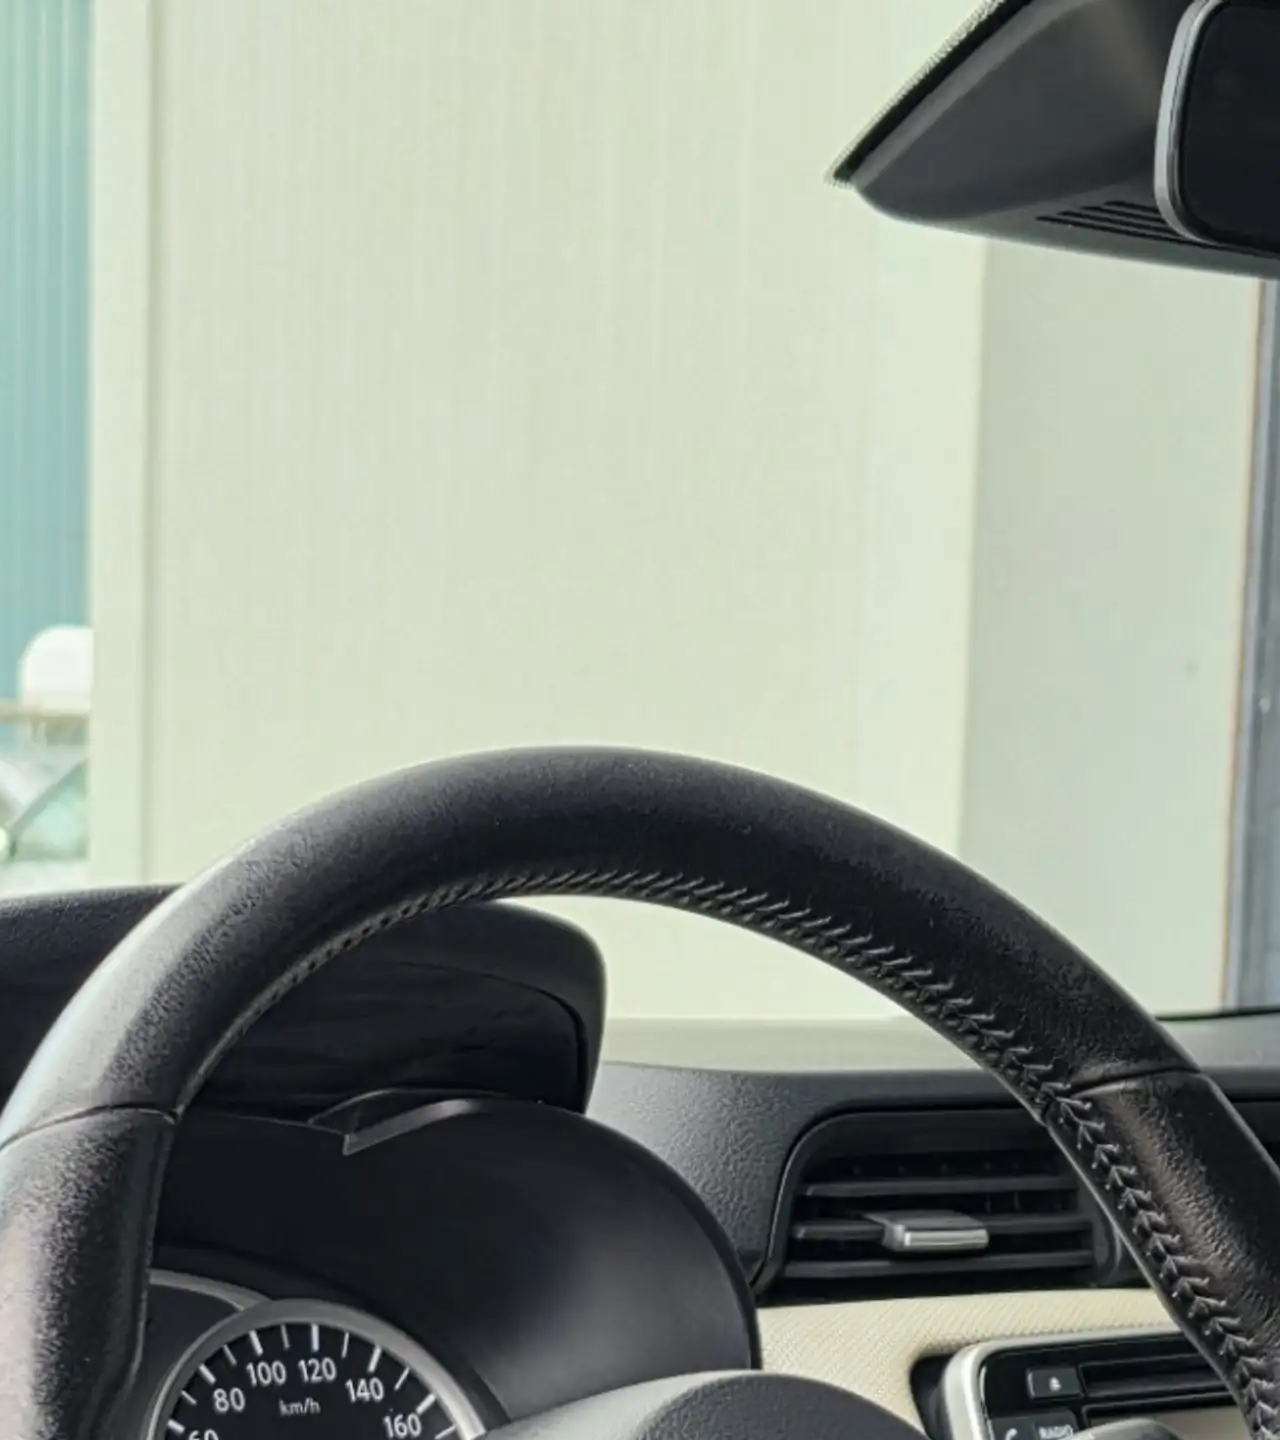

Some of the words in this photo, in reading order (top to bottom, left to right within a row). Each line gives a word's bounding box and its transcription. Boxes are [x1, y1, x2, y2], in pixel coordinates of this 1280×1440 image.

[245, 1360, 287, 1387] 100
[297, 1357, 337, 1384] 120
[213, 1387, 246, 1414] 80
[344, 1377, 385, 1403] 140
[279, 1398, 321, 1416] km/h
[383, 1413, 423, 1440] 160
